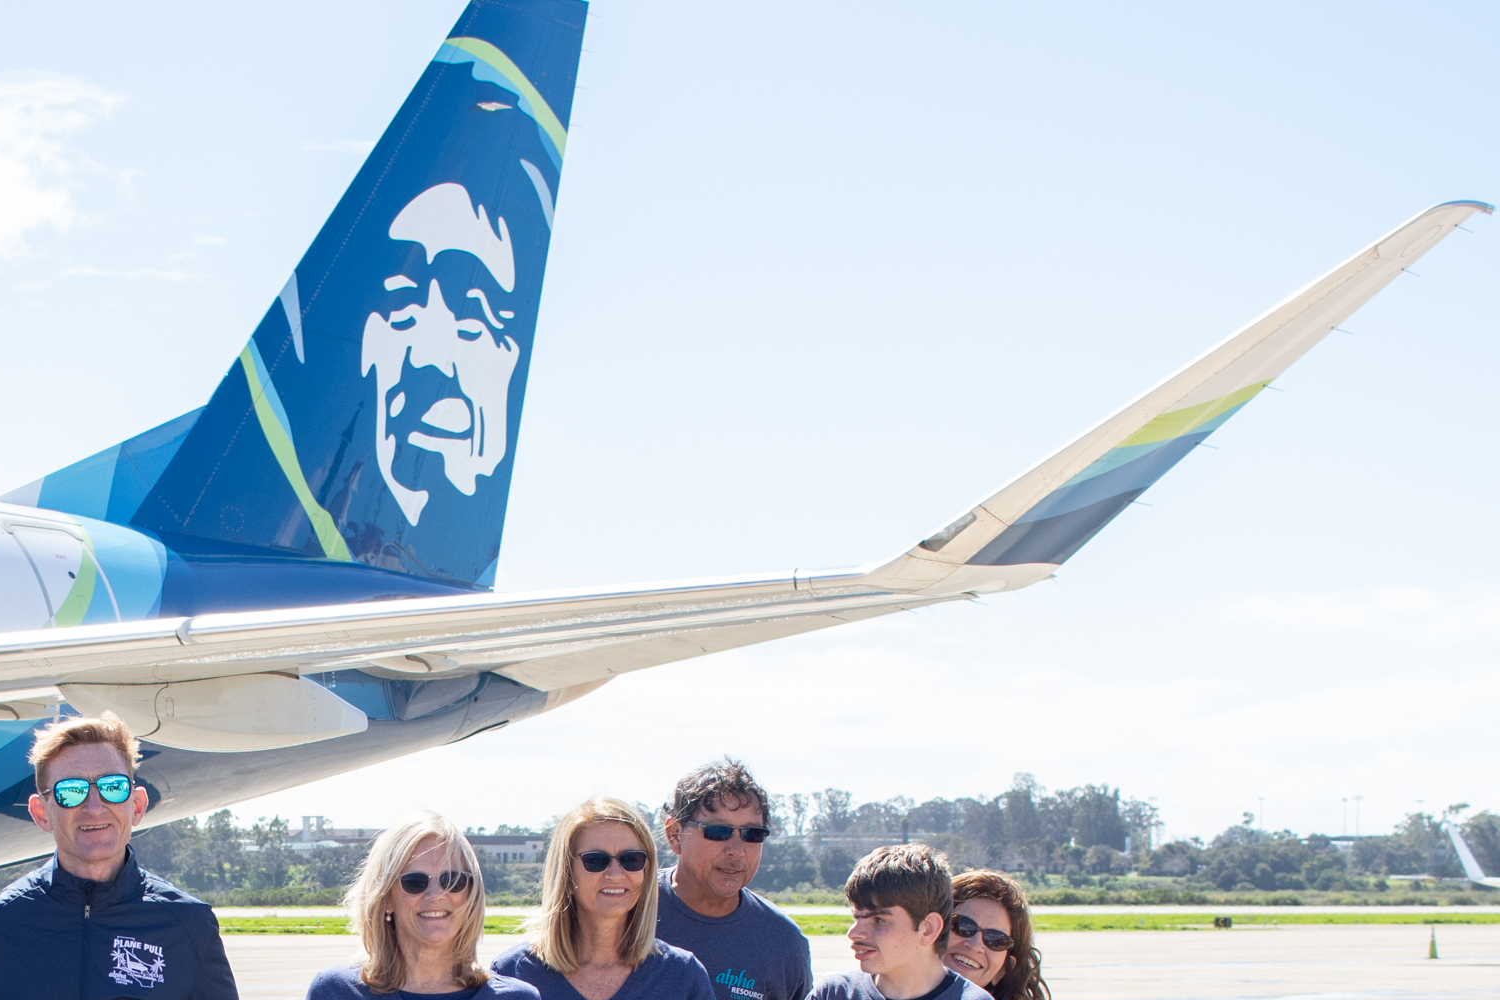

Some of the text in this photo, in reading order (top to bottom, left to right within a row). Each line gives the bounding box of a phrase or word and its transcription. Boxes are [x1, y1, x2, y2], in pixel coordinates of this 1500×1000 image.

[113, 938, 164, 958] PLANE PULL
[715, 968, 756, 990] alpha
[731, 986, 765, 1000] RESOURCE
